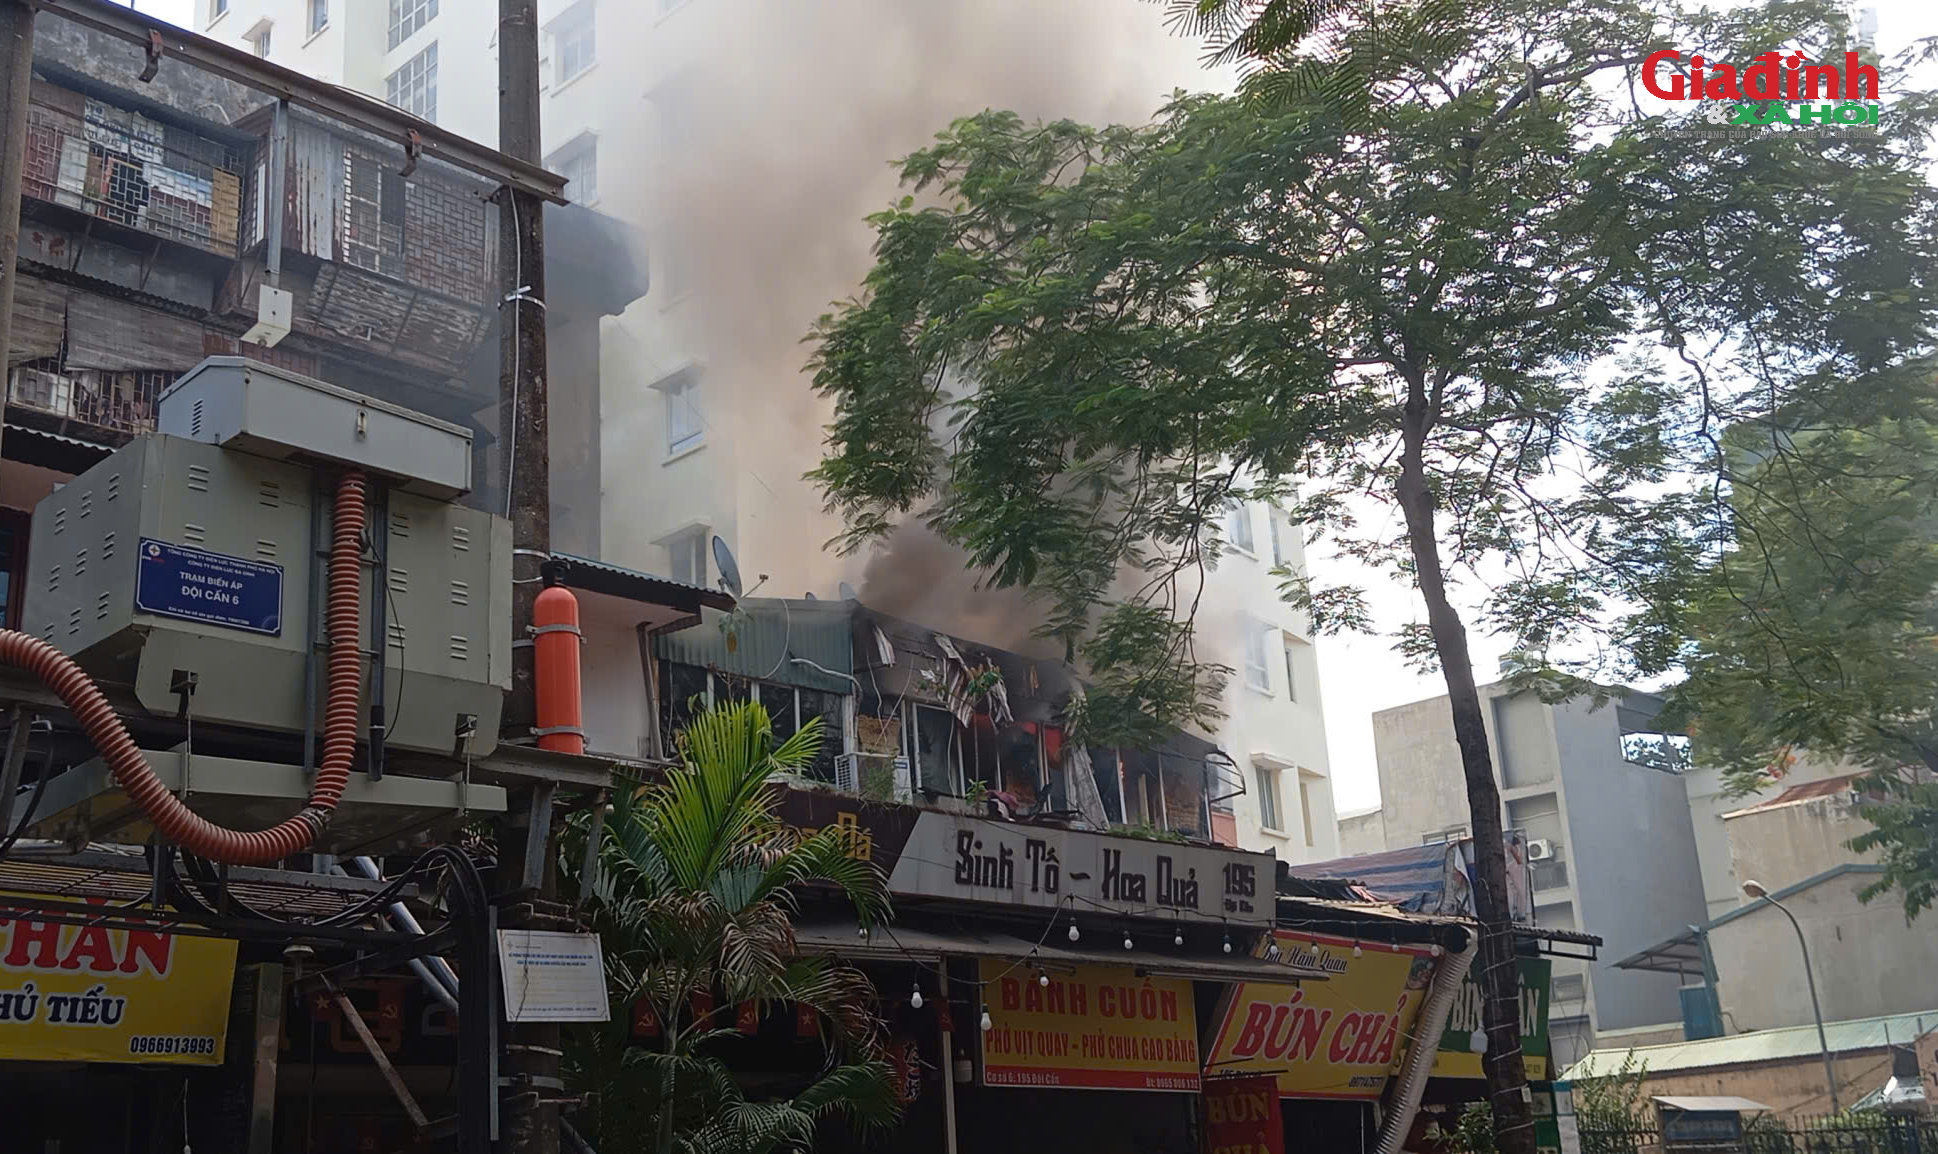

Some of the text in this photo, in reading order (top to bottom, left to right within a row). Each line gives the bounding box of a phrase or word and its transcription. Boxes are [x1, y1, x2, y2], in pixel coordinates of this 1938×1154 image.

[180, 571, 243, 590] TRẠM BIẾN ÁP
[181, 585, 240, 605] ĐỘI CẤN 6
[955, 830, 1013, 889] Sinh
[1102, 848, 1146, 903] Hoa
[1156, 855, 1199, 908] Quả
[1222, 862, 1255, 897] 195
[47, 986, 125, 1025] TIẾU
[1232, 990, 1407, 1065] BÚN CHẢ
[1013, 1030, 1034, 1060] VỊT
[1037, 1031, 1069, 1057] QUAY
[1108, 1035, 1139, 1061] CHUA
[1141, 1037, 1163, 1061] CAO
[1205, 1087, 1269, 1122] BÚN
